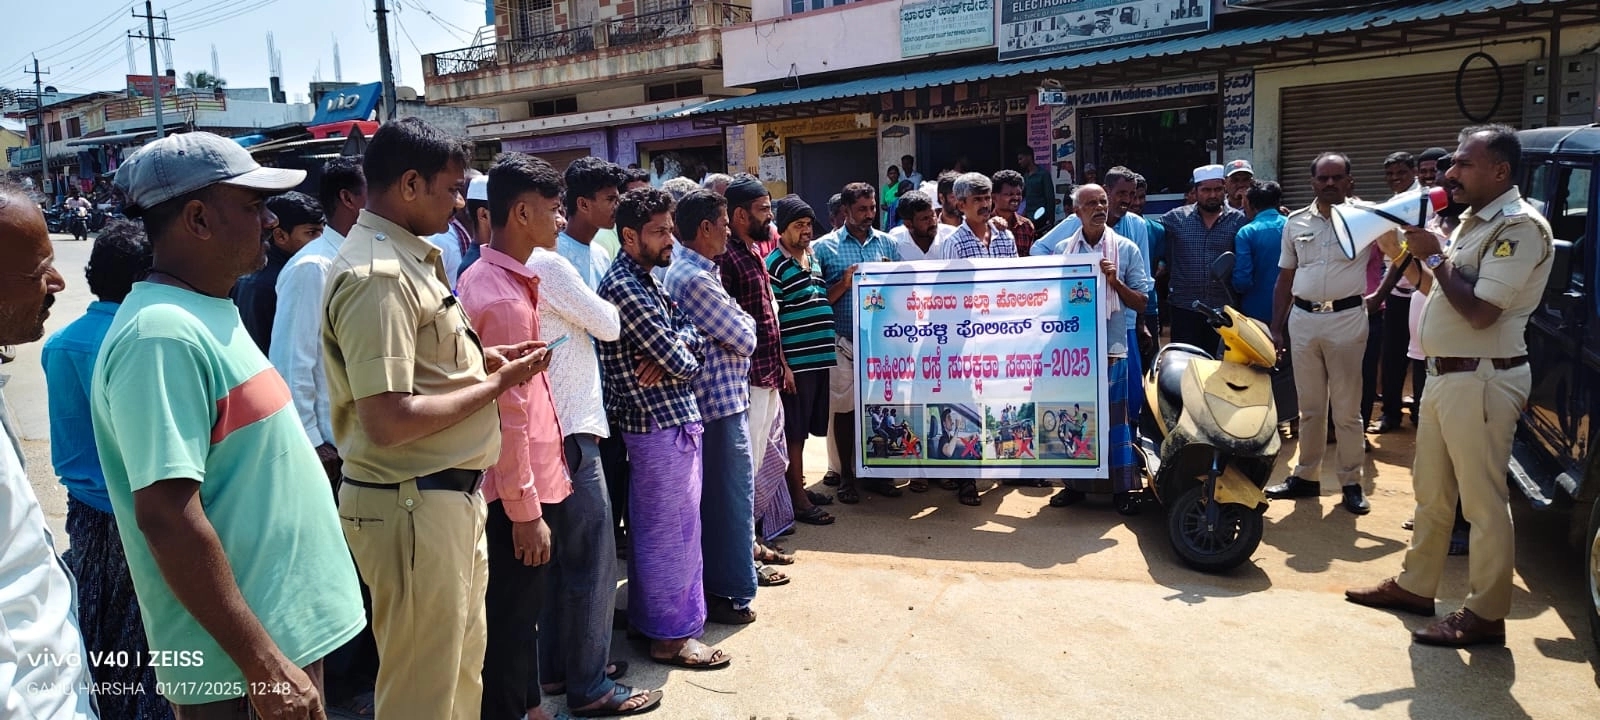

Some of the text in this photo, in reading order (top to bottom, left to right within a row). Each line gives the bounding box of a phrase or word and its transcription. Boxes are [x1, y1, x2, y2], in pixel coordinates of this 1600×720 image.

[1012, 0, 1083, 13] ELECTRO
[906, 288, 1049, 319] ಮೈಸೂರು ಜಿಲ್ಲಾ ಪೊಲೀಸ್
[883, 316, 1080, 345] ಹುಲ್ಲಹಳ್ಳಿ ಪೊಲೀಸ್ ಠಾಣೆ
[866, 355, 916, 401] ರಾಷ್ಟ್ರೀಯ
[922, 346, 941, 392] ರಸ್ತೆ
[948, 353, 999, 395] ಸುರಕ್ಷತಾ
